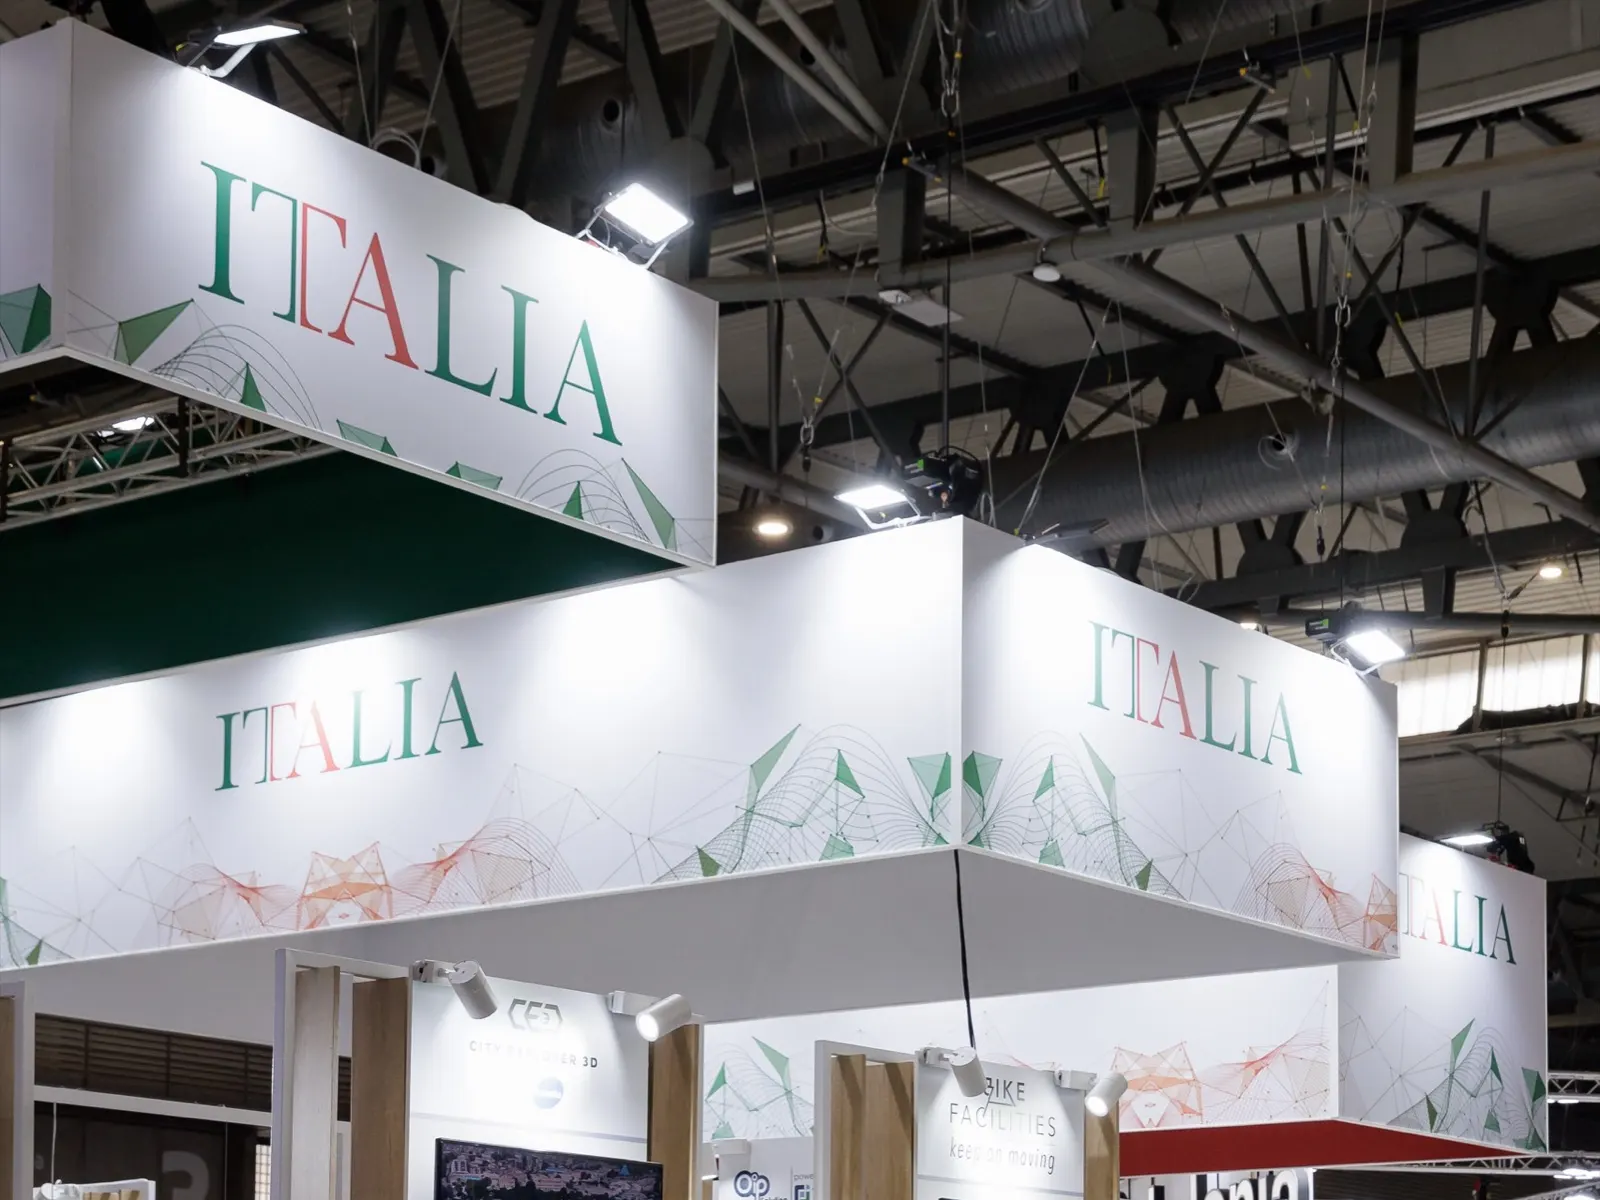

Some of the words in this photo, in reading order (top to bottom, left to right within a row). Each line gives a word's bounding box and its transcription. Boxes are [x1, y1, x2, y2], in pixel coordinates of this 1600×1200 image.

[197, 160, 624, 447] ITALIA
[215, 670, 484, 792] ITALIA
[1086, 620, 1303, 775] ITALIA
[1399, 872, 1518, 965] TALIA
[582, 1056, 598, 1068] 3D
[949, 1103, 1056, 1137] FACILITIES
